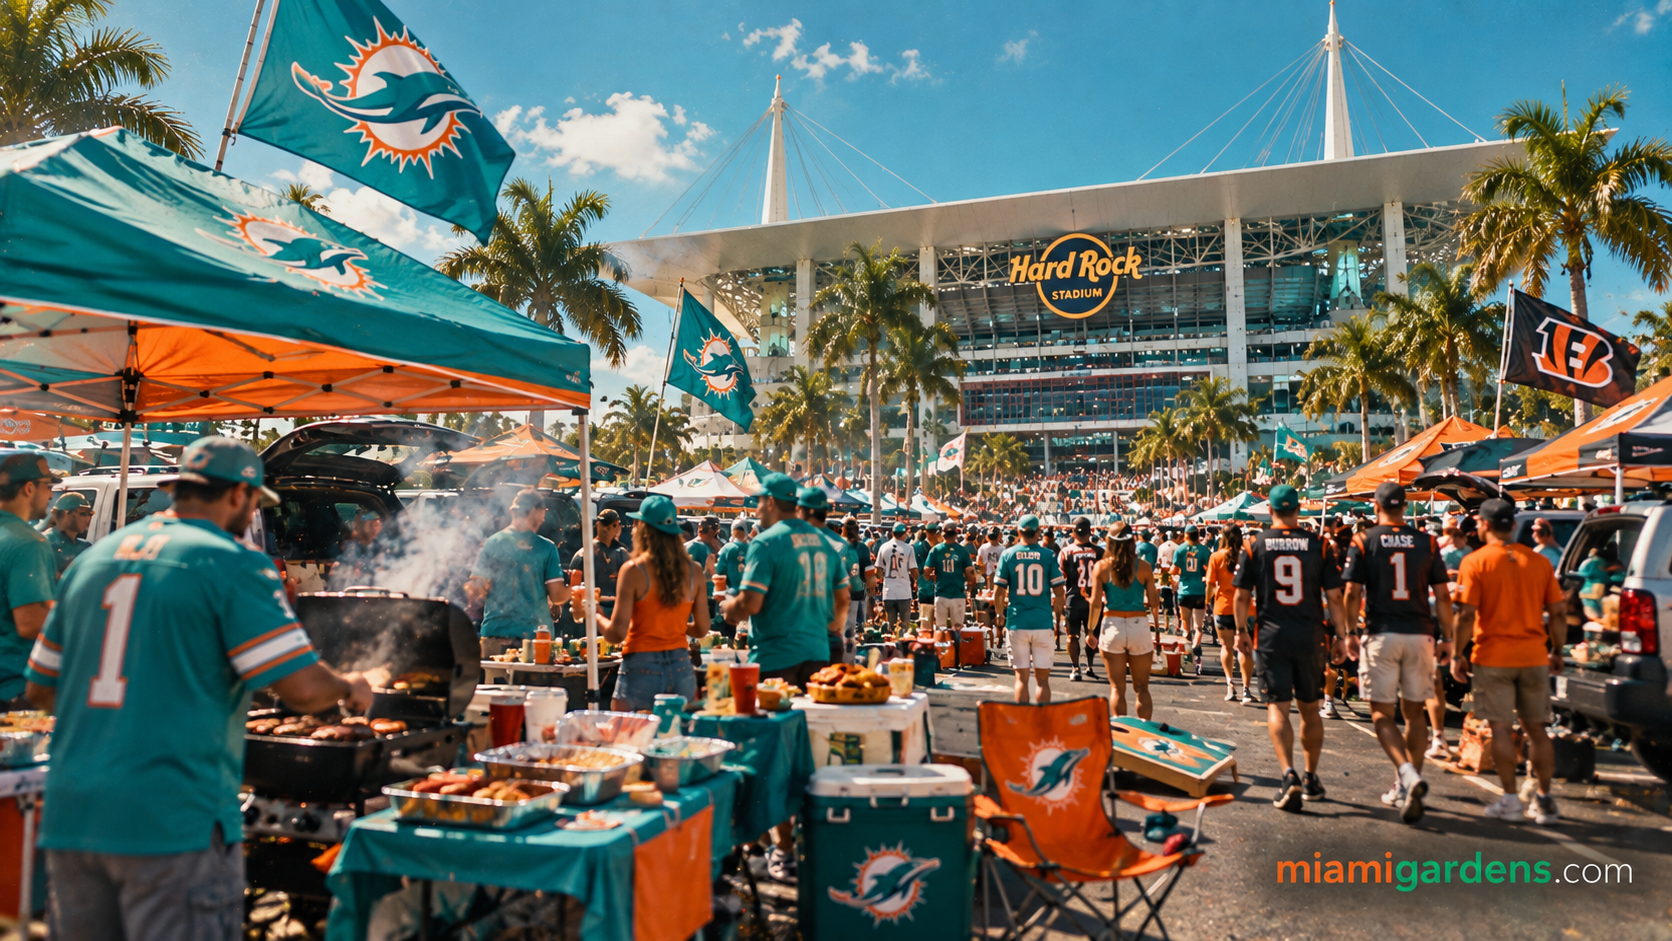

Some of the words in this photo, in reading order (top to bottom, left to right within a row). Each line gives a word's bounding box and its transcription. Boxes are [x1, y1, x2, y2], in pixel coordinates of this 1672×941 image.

[1009, 251, 1077, 283] Hard
[1078, 246, 1143, 283] Rock
[1051, 288, 1103, 300] STADIUM
[1265, 537, 1309, 551] BURROW
[1380, 534, 1415, 548] CHASE
[1015, 563, 1044, 597] 10
[1273, 555, 1303, 606] 9
[1389, 552, 1410, 600] 1
[87, 572, 143, 709] 1
